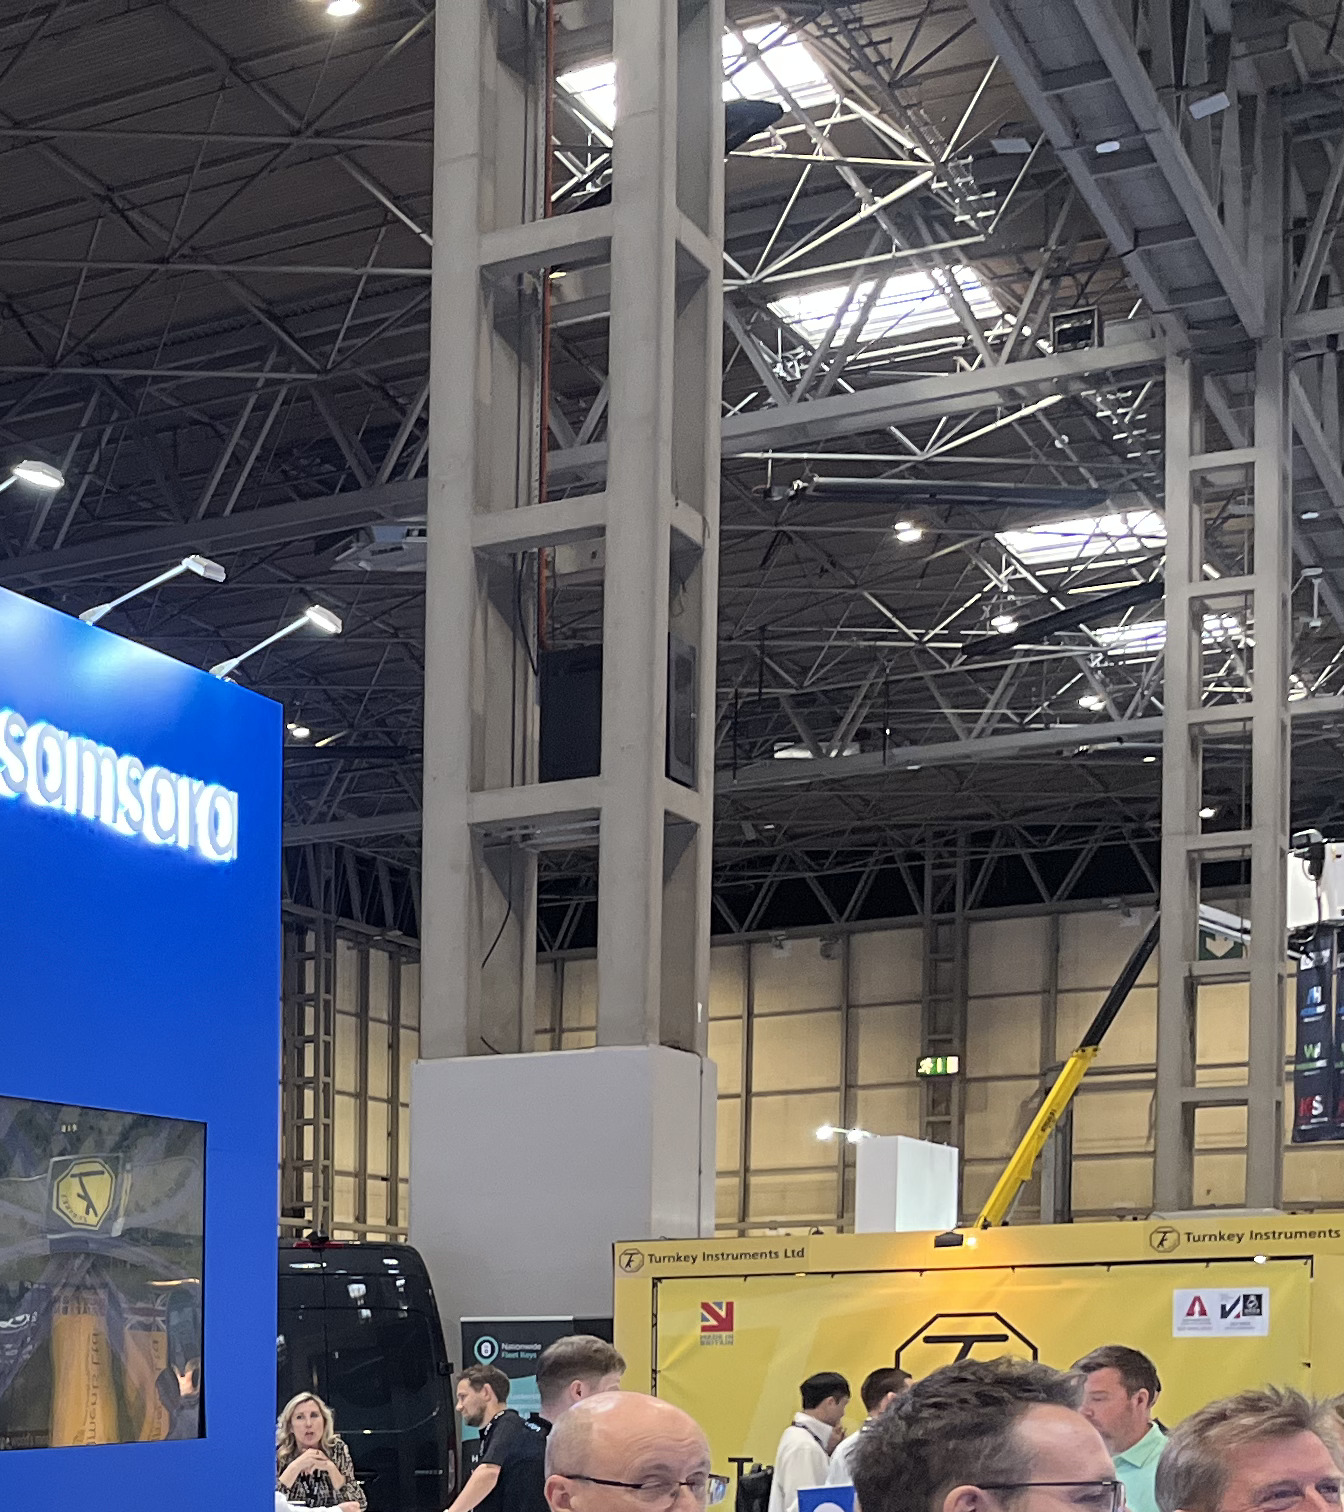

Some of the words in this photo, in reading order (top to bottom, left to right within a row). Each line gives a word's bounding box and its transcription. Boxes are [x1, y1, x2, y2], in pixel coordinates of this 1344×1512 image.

[1184, 1231, 1245, 1244] Turnkey
[1249, 1228, 1341, 1241] Instruments
[647, 1253, 698, 1265] Turnkey
[702, 1249, 780, 1262] Instruments
[784, 1247, 805, 1259] Ltd
